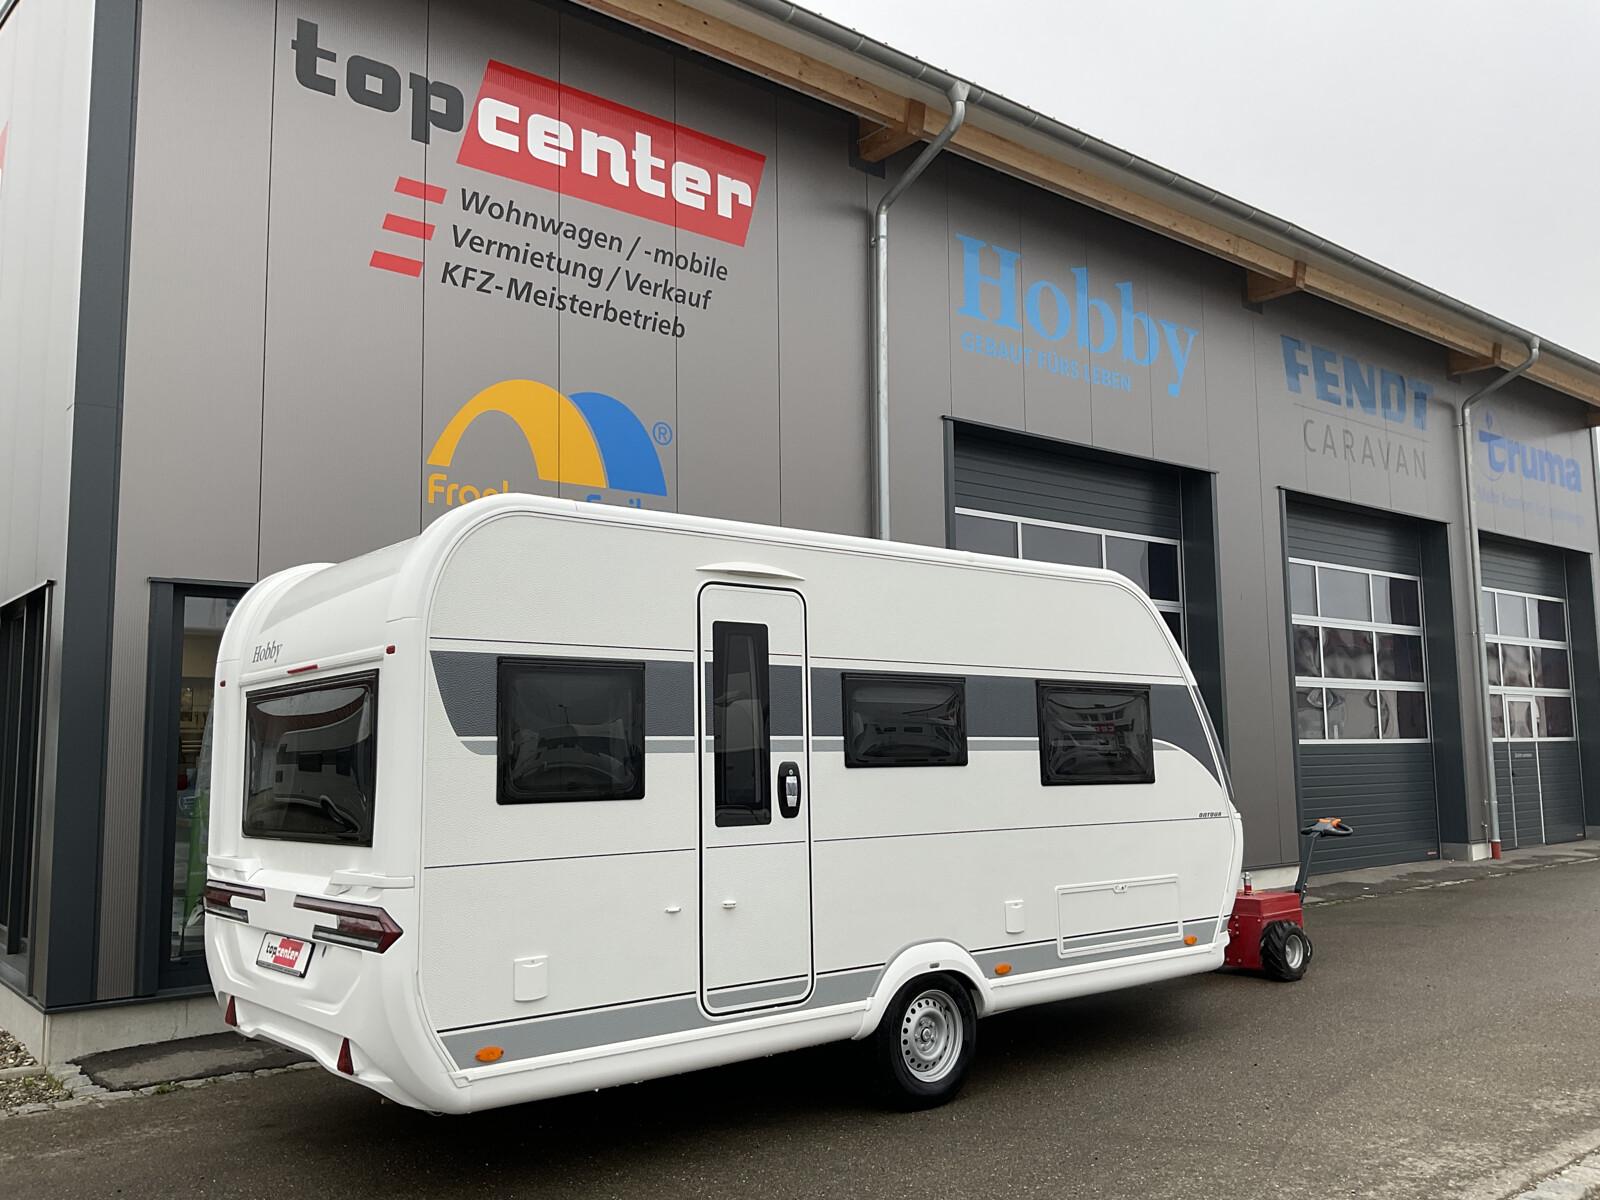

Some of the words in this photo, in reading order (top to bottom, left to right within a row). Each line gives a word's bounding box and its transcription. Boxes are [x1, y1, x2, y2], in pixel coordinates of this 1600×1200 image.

[460, 187, 623, 252] Wohnwagen
[441, 261, 686, 338] KFZ-Meisterbetrieb
[452, 224, 604, 289] Vermietung
[625, 269, 713, 310] Verkauf
[955, 232, 1199, 397] Hobby
[1280, 335, 1435, 431] FENDT
[1303, 419, 1428, 480] CARAVAN
[252, 640, 283, 663] Hobby
